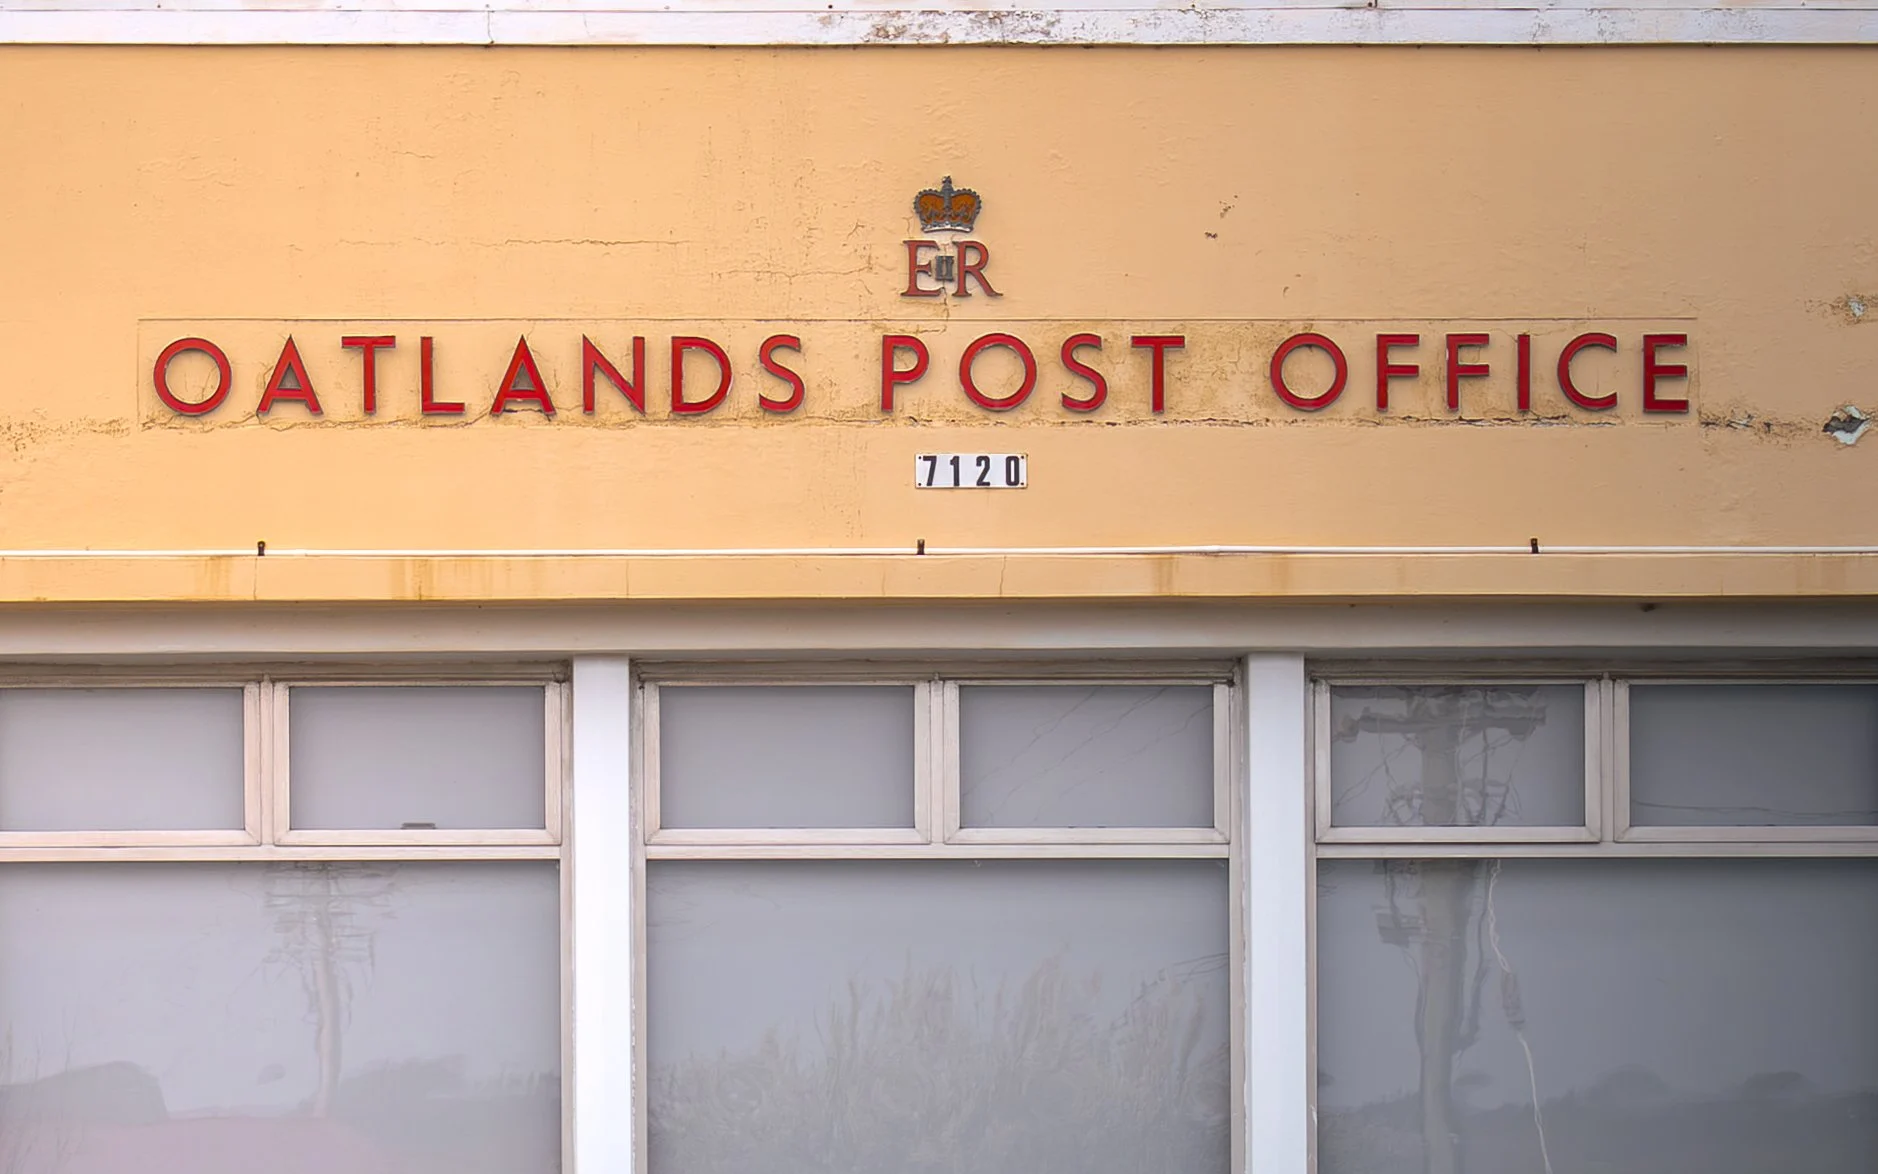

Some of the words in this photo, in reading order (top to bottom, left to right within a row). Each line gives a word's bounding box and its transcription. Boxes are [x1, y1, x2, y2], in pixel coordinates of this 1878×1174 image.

[153, 334, 805, 416] OATLANDS
[880, 333, 1185, 413] POST
[1269, 333, 1689, 413] OFFICE
[922, 455, 1020, 487] 7120
